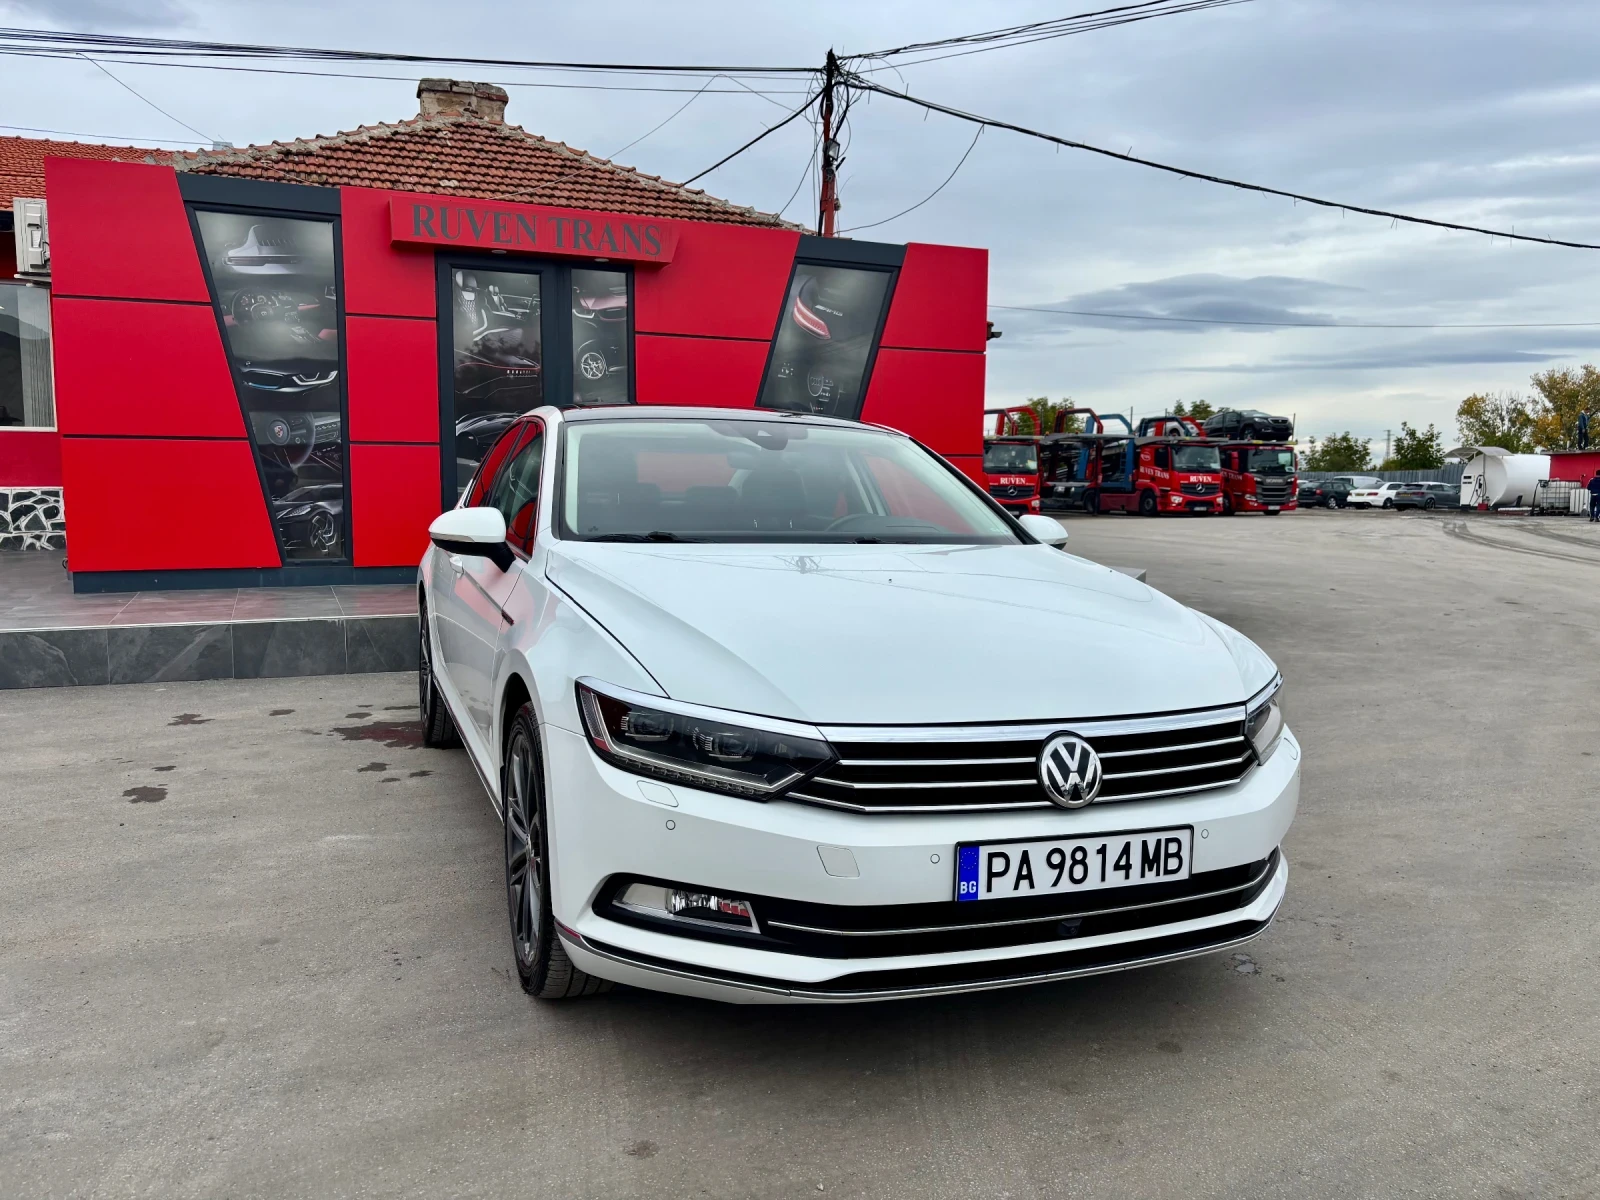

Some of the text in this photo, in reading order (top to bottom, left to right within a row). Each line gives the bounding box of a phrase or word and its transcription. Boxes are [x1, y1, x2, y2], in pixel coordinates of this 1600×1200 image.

[411, 203, 661, 257] RUVEN TRANS
[1000, 477, 1026, 485] RUVEN
[986, 837, 1183, 893] PA 9814 MB
[960, 881, 977, 895] BG
